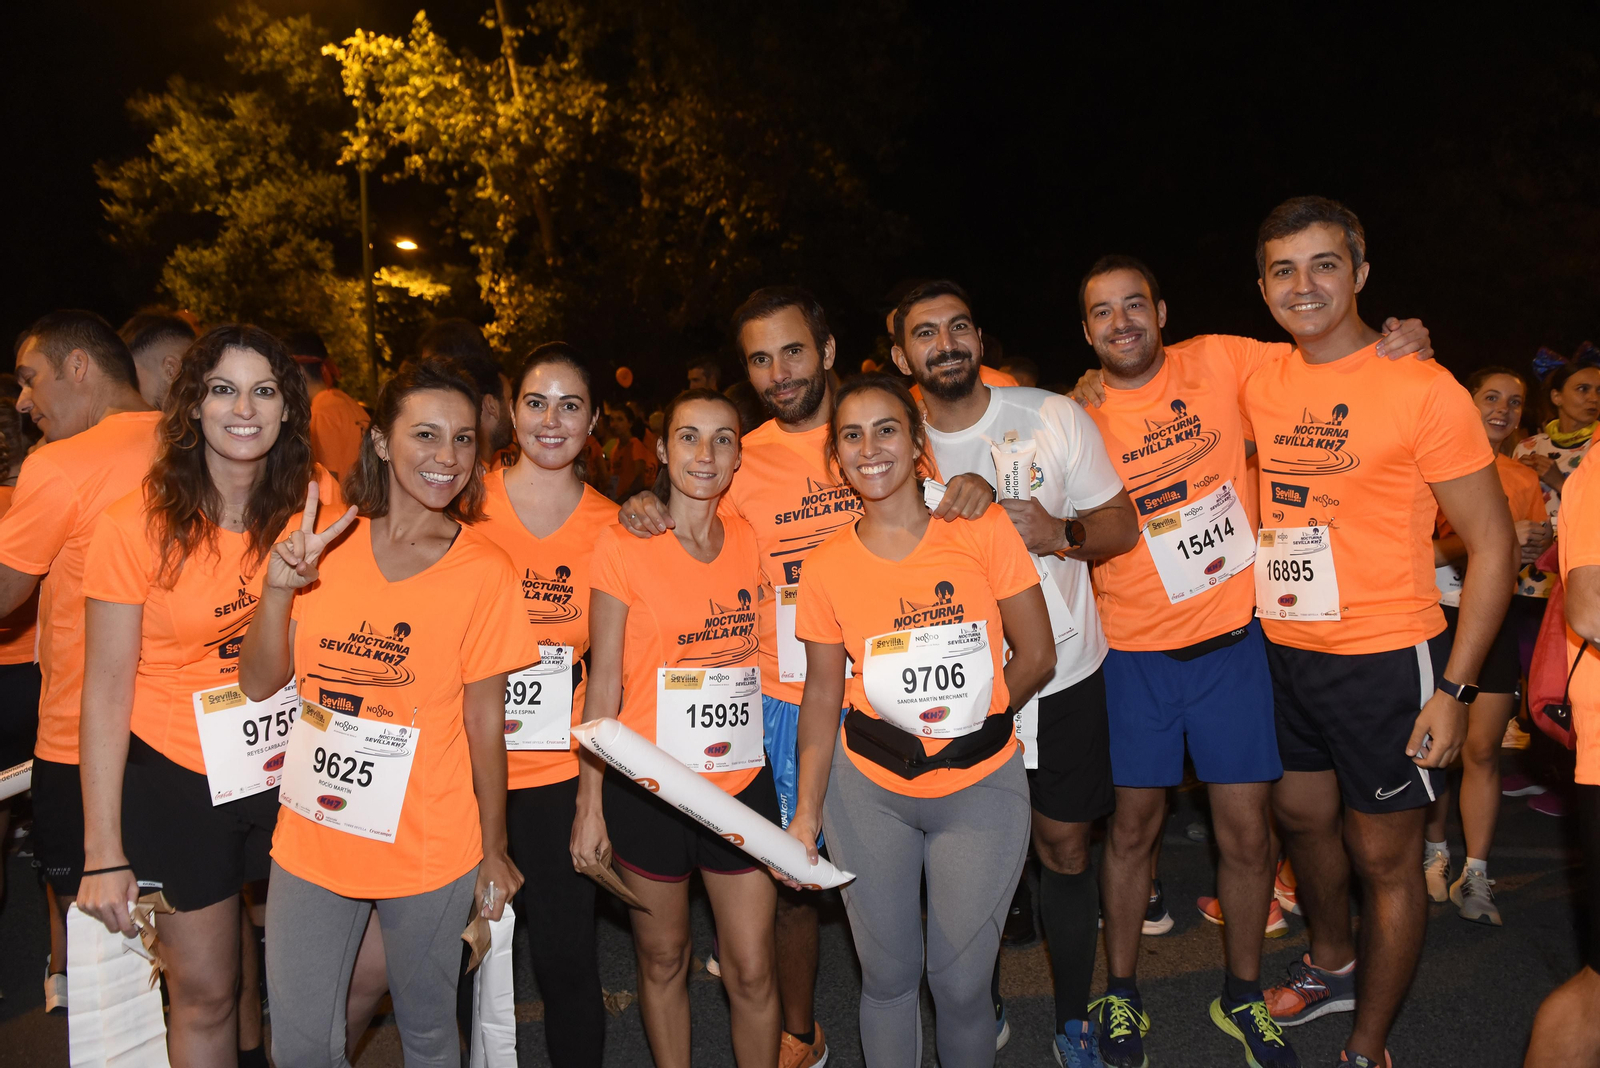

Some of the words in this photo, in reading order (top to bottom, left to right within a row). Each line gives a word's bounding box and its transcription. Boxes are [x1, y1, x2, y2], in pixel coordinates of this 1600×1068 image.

[1144, 414, 1201, 444] NOCTURNA
[1293, 425, 1349, 438] NOCTURNA
[1122, 438, 1174, 464] SEVILLA
[1273, 434, 1313, 448] SEVILLA
[801, 487, 861, 506] NOCTURN
[775, 504, 831, 525] SEVILLA
[1177, 517, 1235, 560] 15414
[1267, 559, 1314, 581] 16895
[214, 595, 257, 617] SEVILL
[894, 604, 965, 629] NOCTURNA
[704, 613, 756, 628] NOCTURNA
[319, 638, 373, 659] SEVILLA
[348, 633, 410, 655] NOCTURNA
[677, 630, 730, 646] SEVILLA
[947, 638, 970, 646] SEVILLA
[902, 662, 966, 694] 9706
[938, 692, 968, 700] MERCHANTE
[686, 702, 749, 728] 15935
[246, 747, 264, 757] REYES
[264, 742, 286, 753] CARBAJO
[364, 736, 391, 746] SEVILLA
[313, 746, 374, 788] 9625
[590, 736, 637, 777] nederlanden
[678, 803, 724, 834] nederlanden
